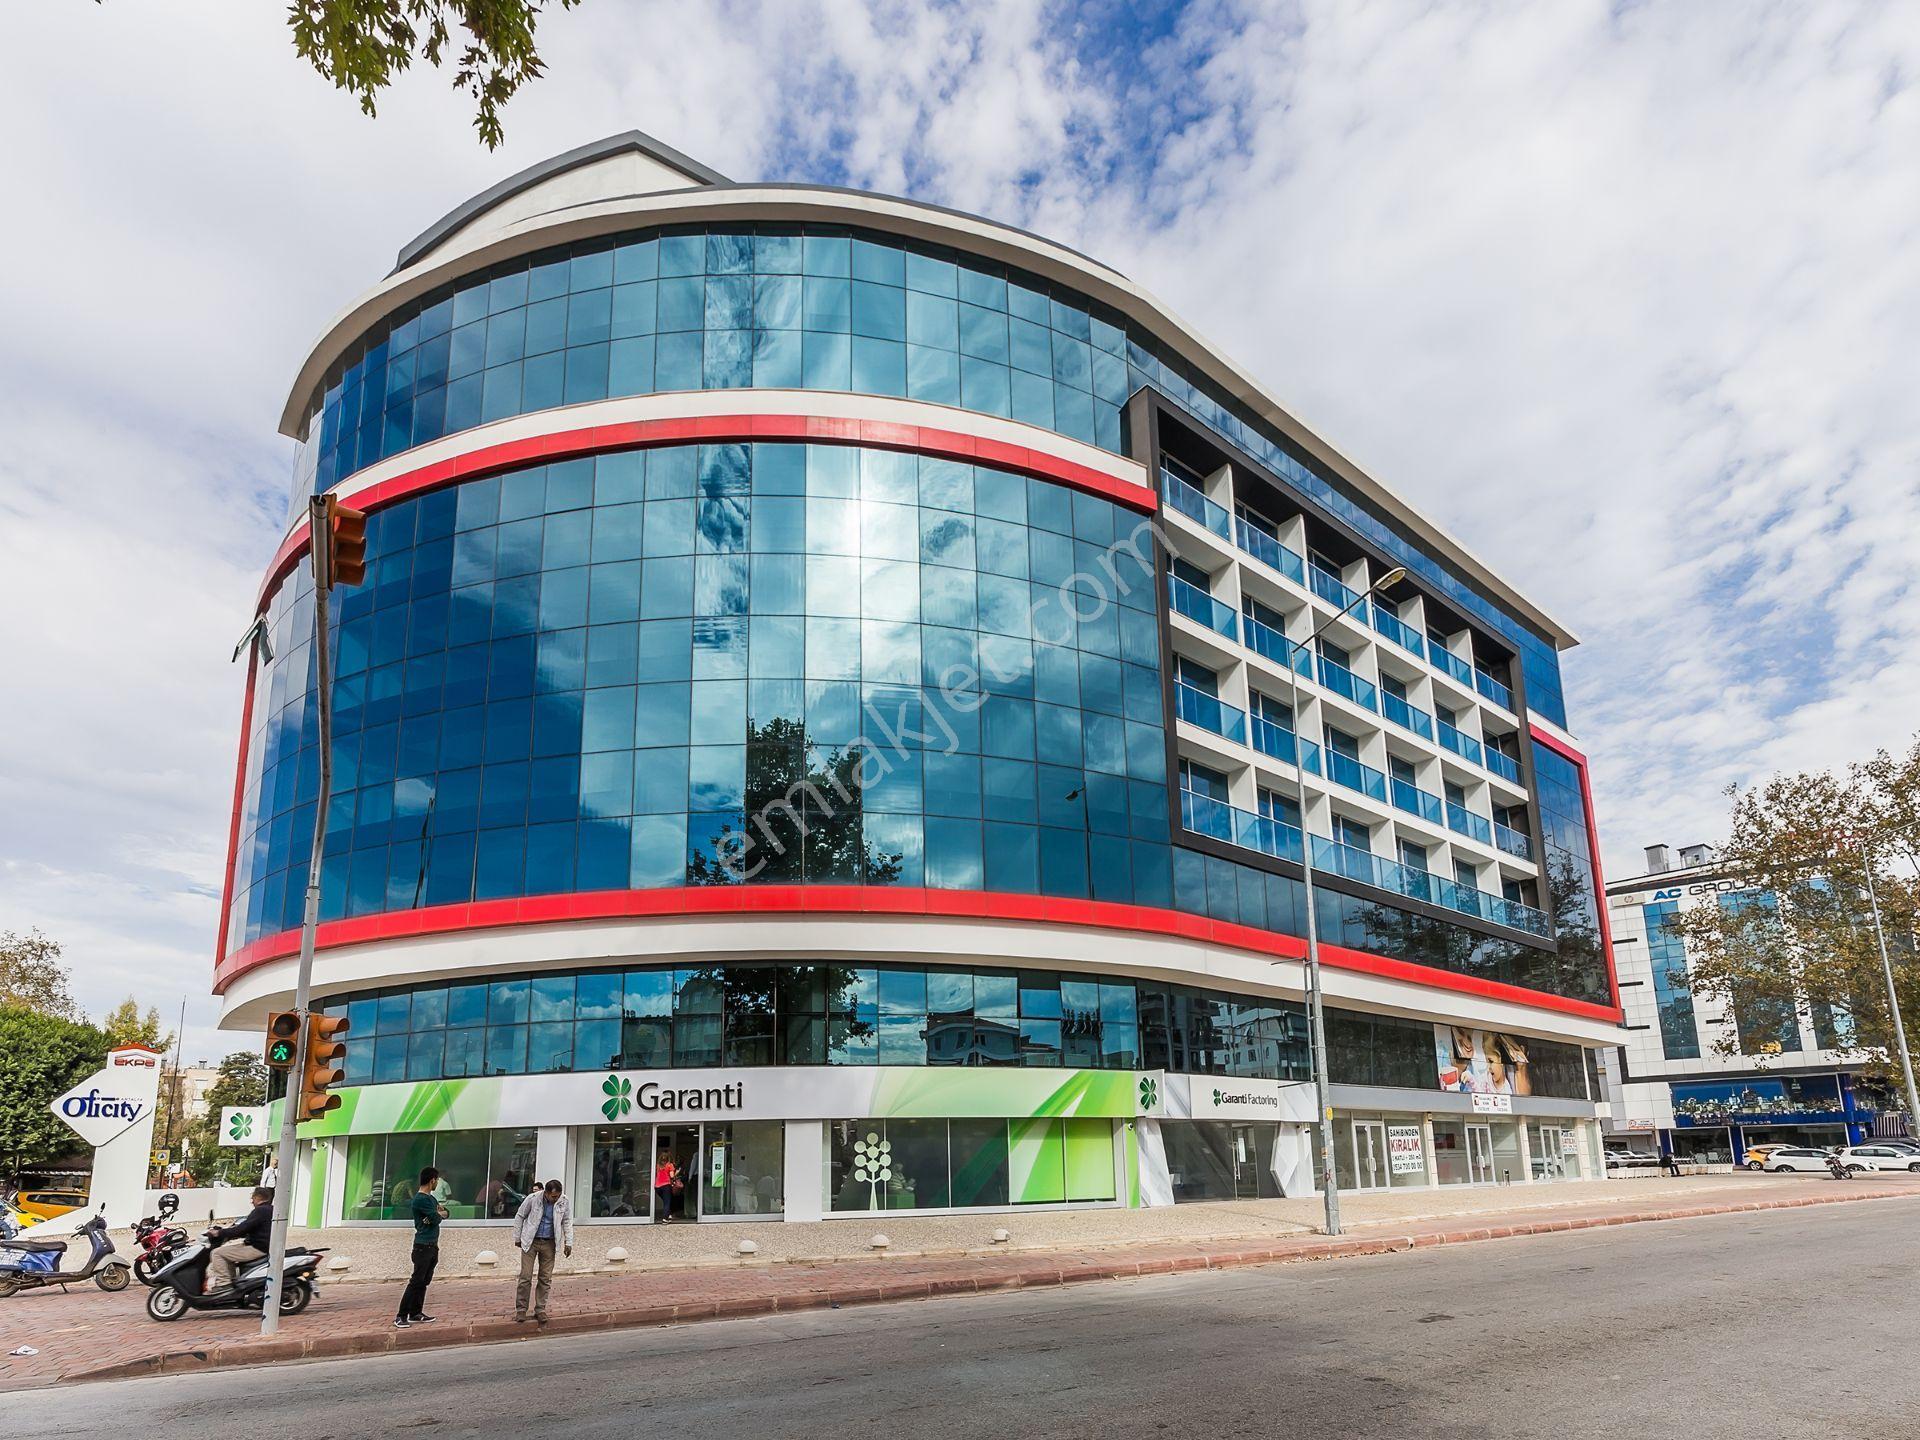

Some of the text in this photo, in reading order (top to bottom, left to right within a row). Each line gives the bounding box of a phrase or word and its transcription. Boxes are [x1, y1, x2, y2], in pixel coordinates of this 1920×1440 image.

[1653, 888, 1682, 901] AC
[62, 1088, 143, 1122] Oficity
[636, 1081, 743, 1111] Garanti
[1221, 1092, 1278, 1108] Garanti Factoring
